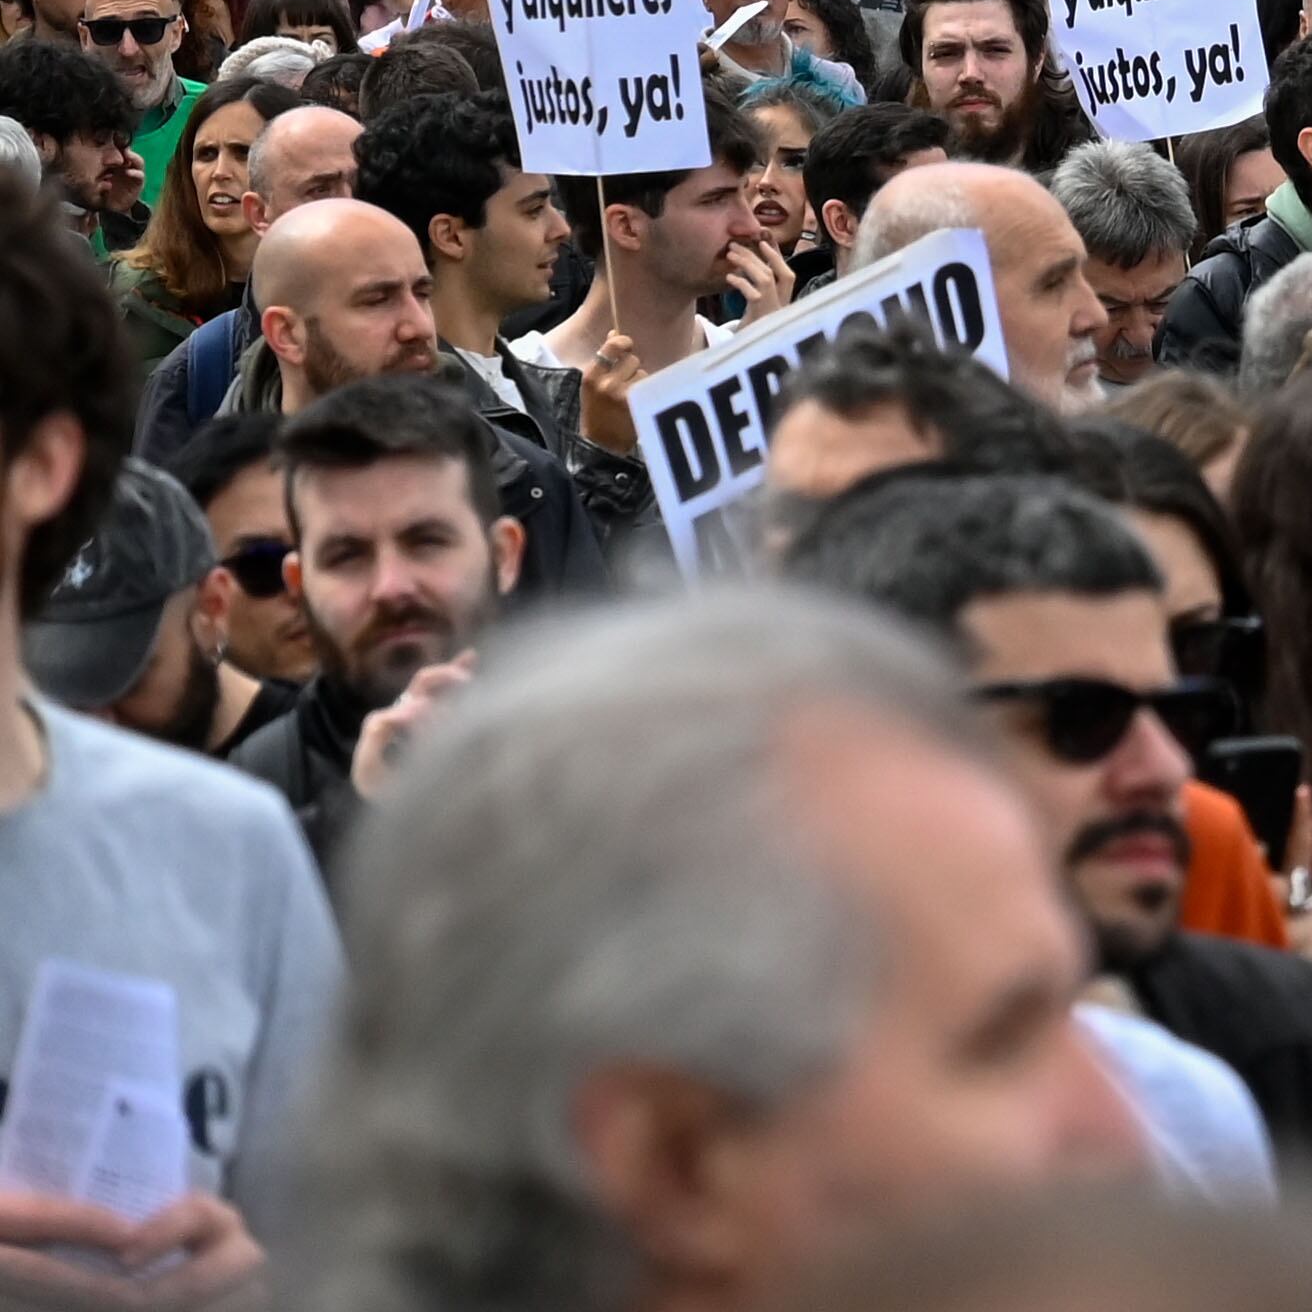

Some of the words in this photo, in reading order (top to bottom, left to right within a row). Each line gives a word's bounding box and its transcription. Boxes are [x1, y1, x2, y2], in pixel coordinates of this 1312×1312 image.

[515, 59, 609, 137] justos,
[618, 53, 685, 139] ya!
[1074, 46, 1177, 117] justos,
[1184, 23, 1245, 103] ya!
